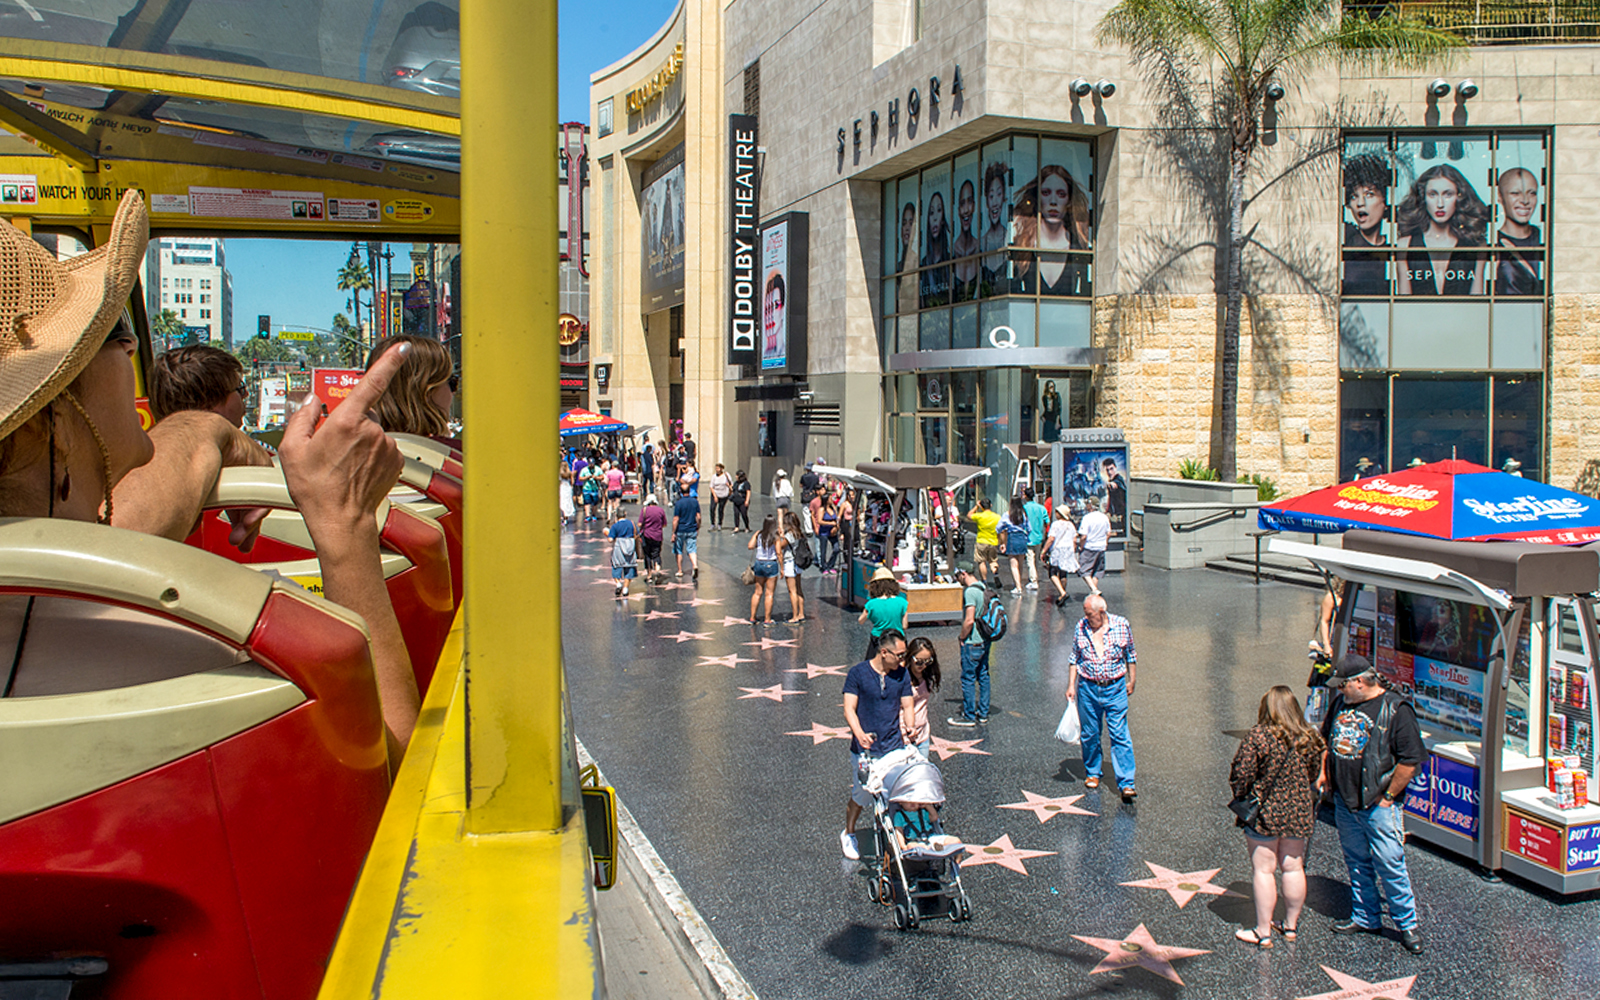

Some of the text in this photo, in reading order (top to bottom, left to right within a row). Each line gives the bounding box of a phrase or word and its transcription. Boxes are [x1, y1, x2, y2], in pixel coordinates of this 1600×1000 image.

[837, 64, 965, 153] SEPHORA
[38, 185, 146, 201] WATCH YOUR HD
[734, 129, 754, 315] DOLBY THEATRE
[1406, 269, 1476, 281] SEPHORA
[989, 326, 1019, 349] Q
[340, 374, 360, 387] Sta
[927, 378, 943, 403] Q
[1060, 432, 1127, 442] DIRECTORY
[1333, 499, 1413, 517] Hop On Hop Off
[1429, 773, 1480, 806] TOURS
[1404, 793, 1436, 815] TARTS
[1437, 805, 1473, 829] HERE
[1568, 828, 1590, 842] BUY
[1567, 844, 1600, 866] Star
